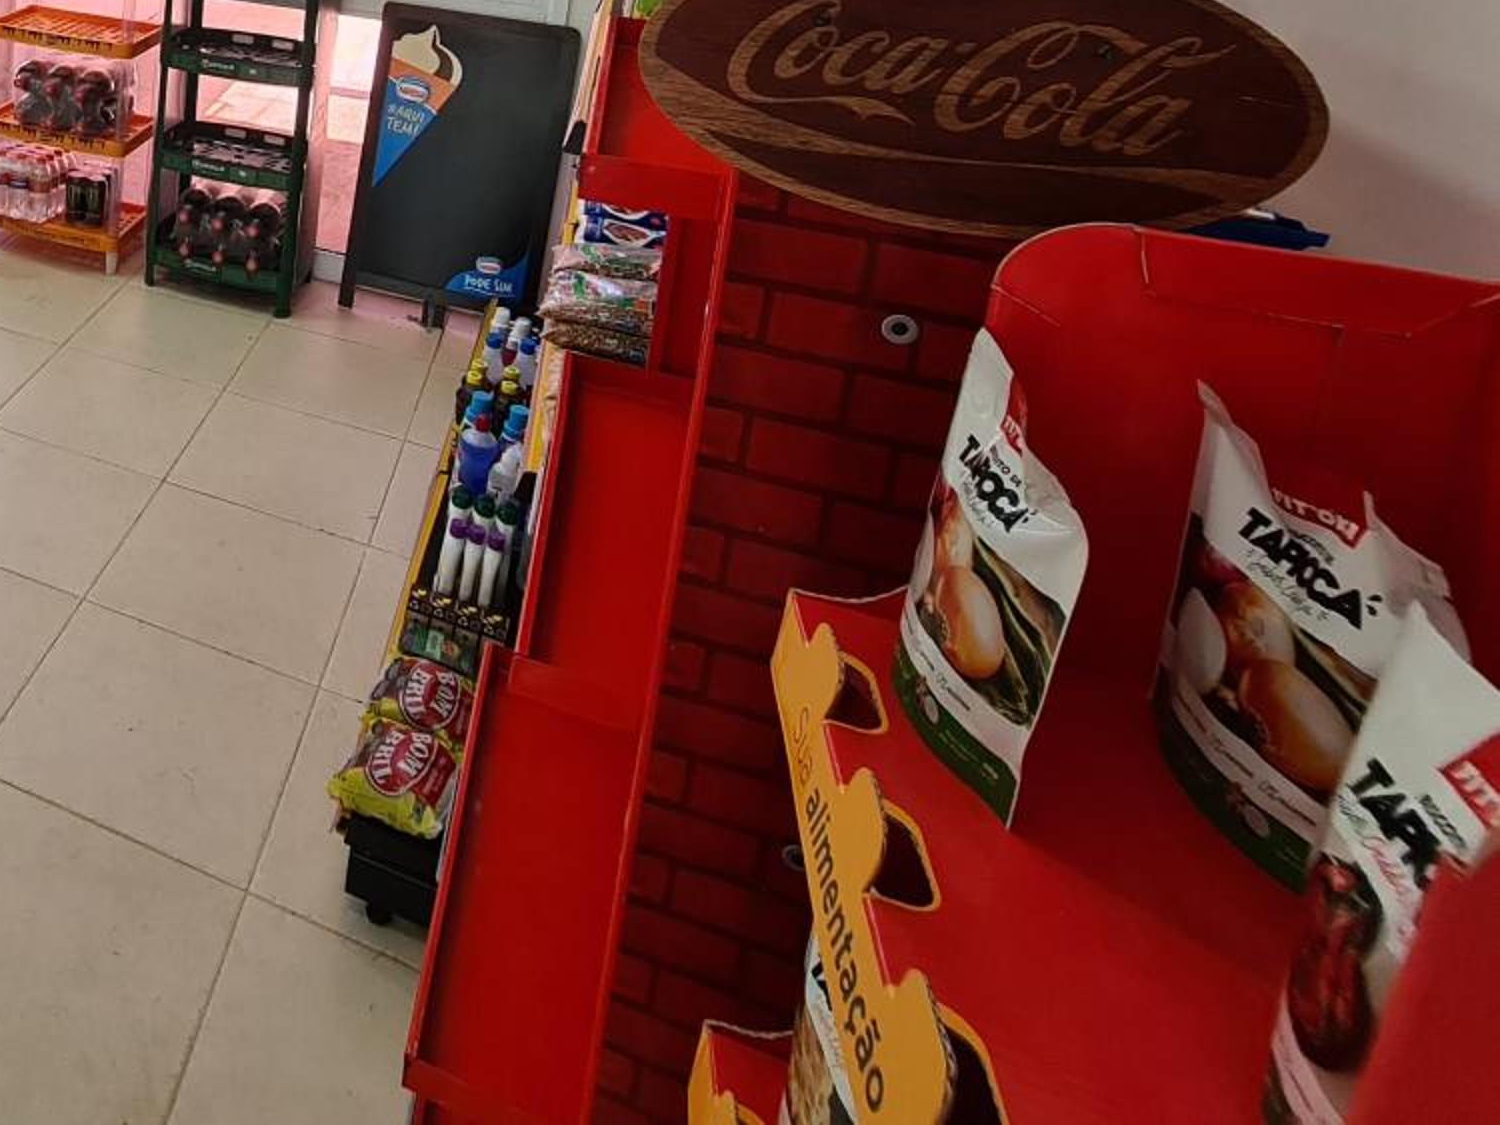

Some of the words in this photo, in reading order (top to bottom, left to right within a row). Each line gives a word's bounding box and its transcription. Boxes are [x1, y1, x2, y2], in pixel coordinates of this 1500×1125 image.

[1238, 506, 1363, 630] TAPIOCA
[792, 707, 816, 787] Sua
[803, 788, 886, 1114] alimentação
